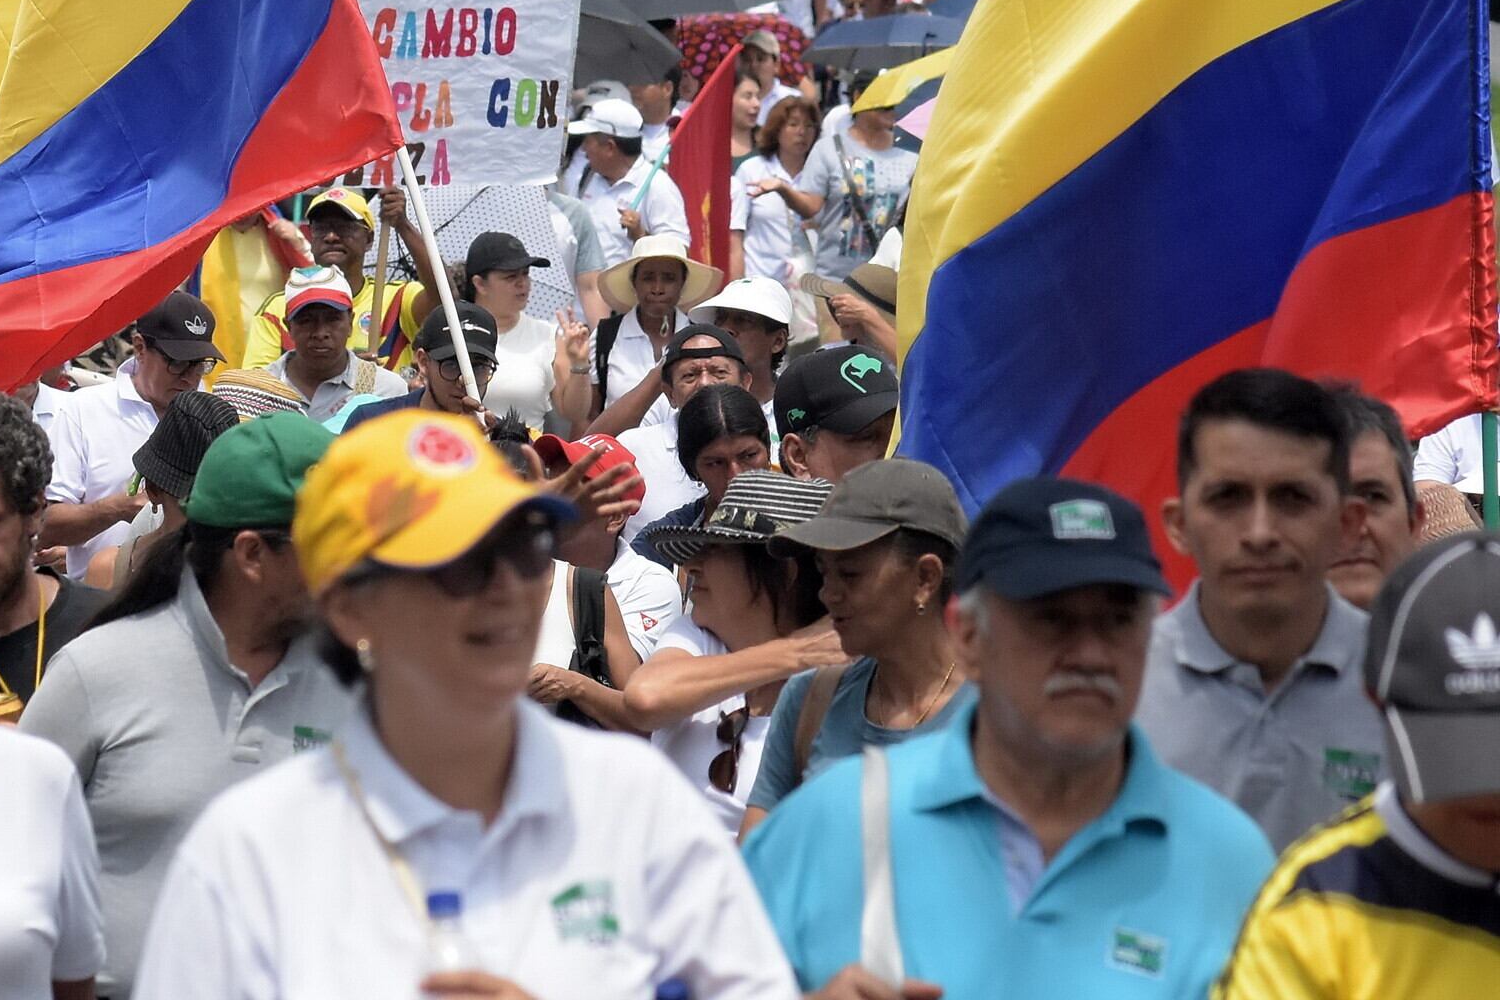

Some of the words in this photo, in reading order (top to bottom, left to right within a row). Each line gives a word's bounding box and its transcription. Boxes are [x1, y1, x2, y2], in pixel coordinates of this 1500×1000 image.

[372, 7, 517, 59] CAMBIO
[391, 79, 454, 132] PLA
[486, 77, 560, 129] CON
